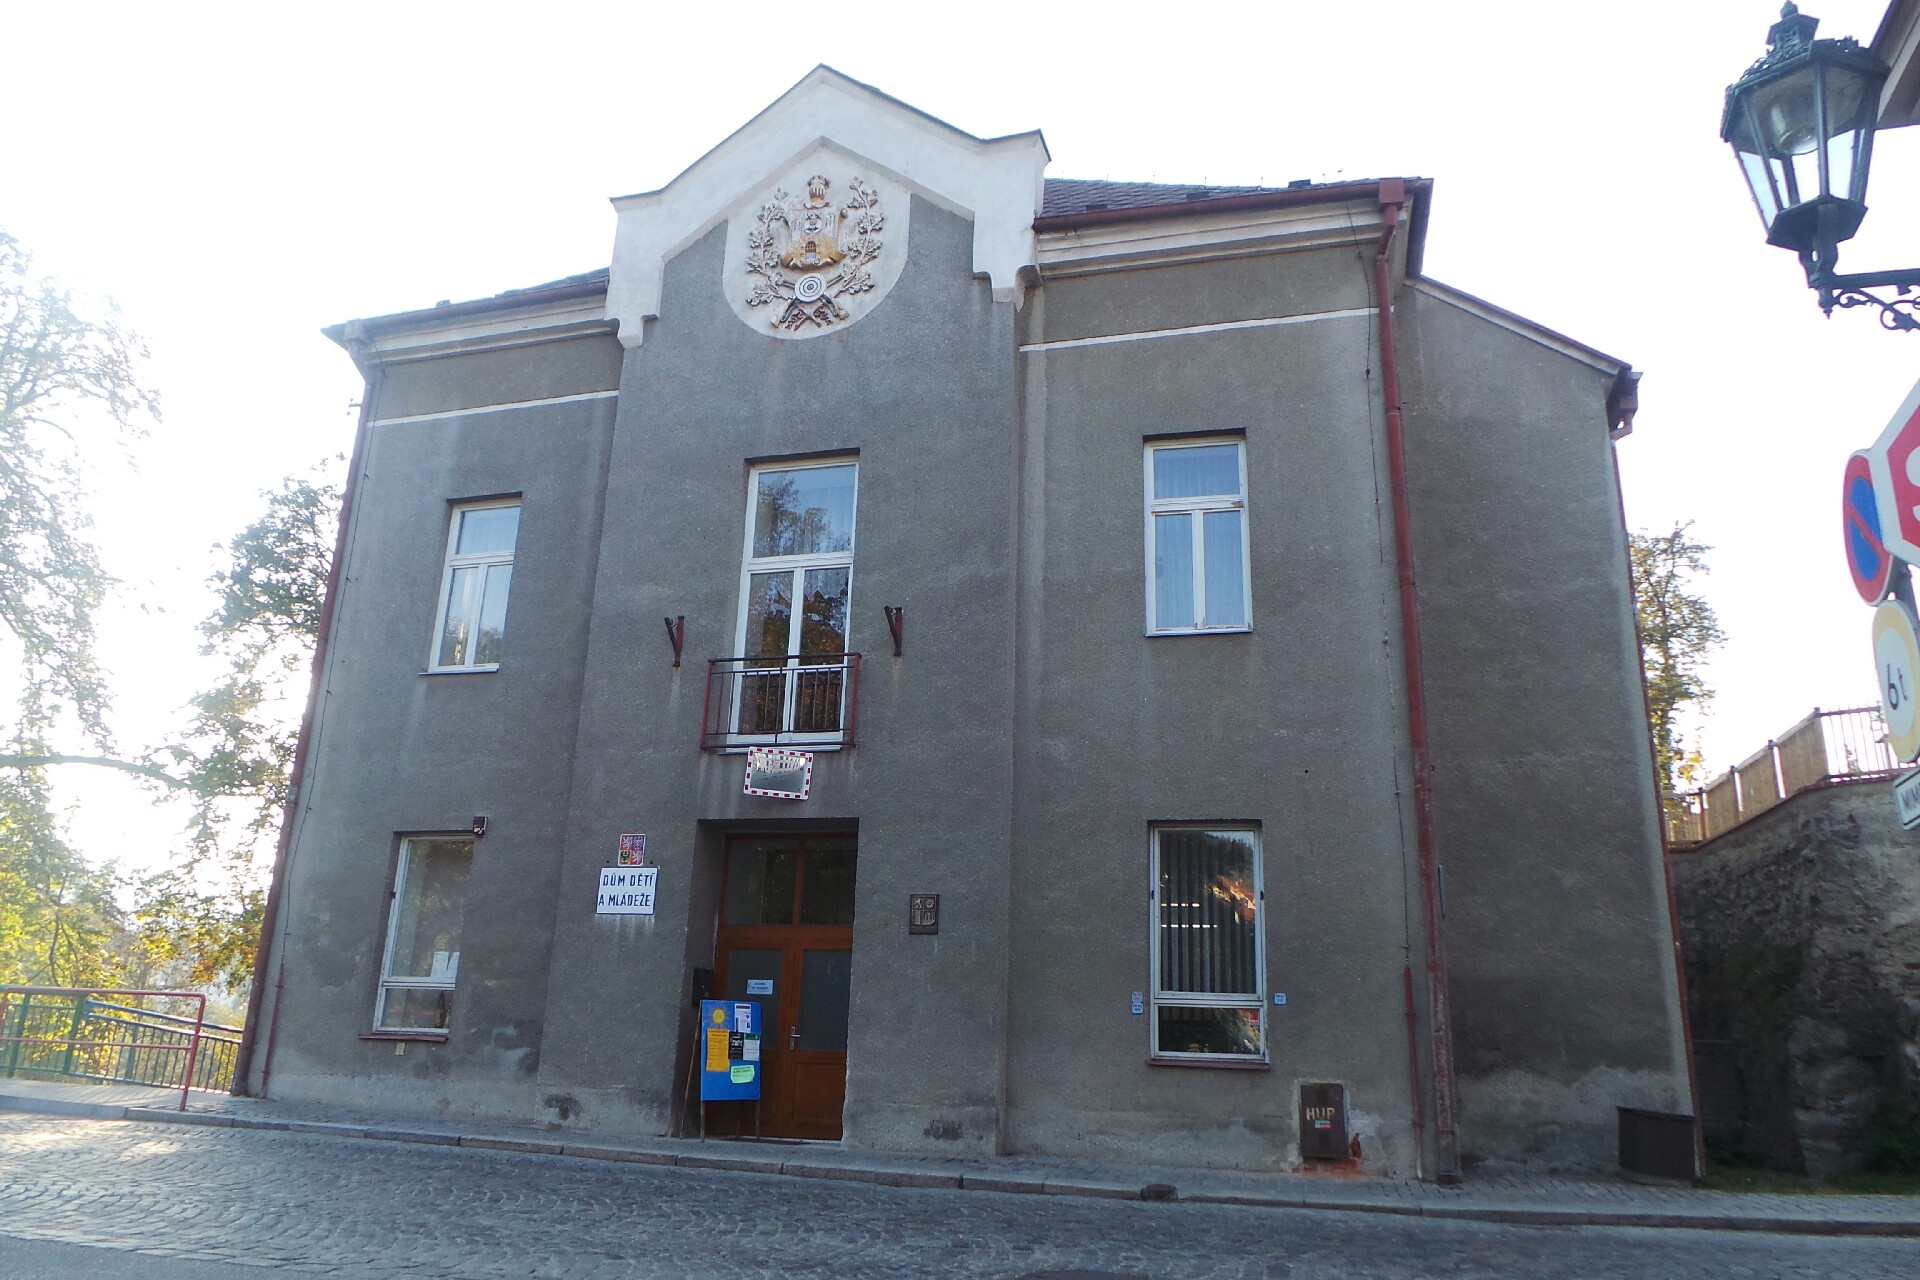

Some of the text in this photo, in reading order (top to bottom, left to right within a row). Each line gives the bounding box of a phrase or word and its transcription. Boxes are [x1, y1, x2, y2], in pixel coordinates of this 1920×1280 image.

[603, 873, 655, 886] DŮM DĚTÍ
[599, 892, 651, 906] A MLÁDEŽE
[1306, 1107, 1335, 1120] HUP
